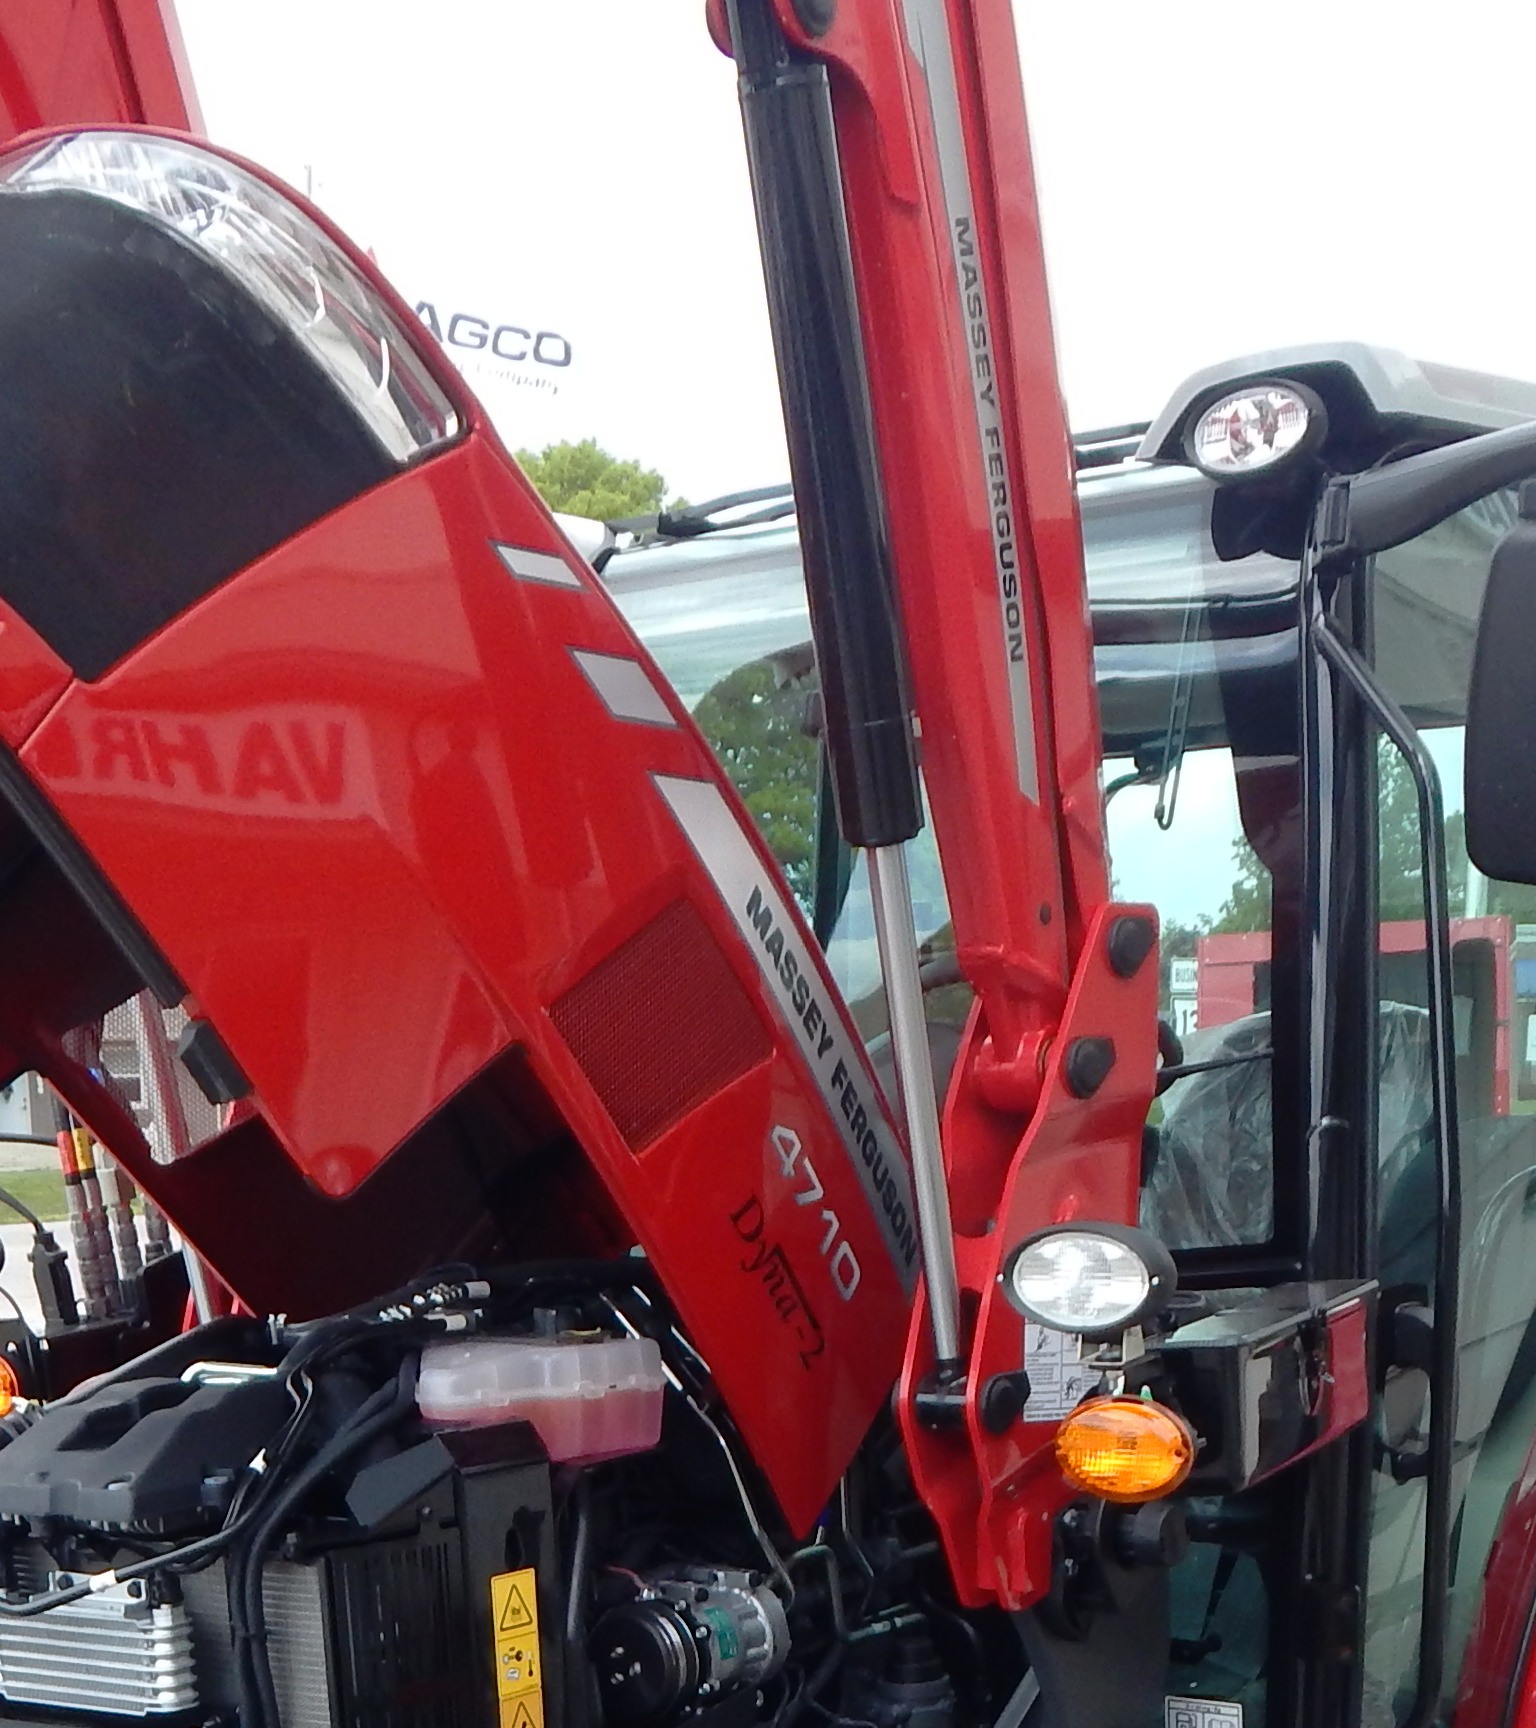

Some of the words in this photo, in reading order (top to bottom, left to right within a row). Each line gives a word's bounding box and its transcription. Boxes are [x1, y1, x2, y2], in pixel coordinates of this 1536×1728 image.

[415, 300, 572, 367] AGCO
[954, 216, 996, 409] MASSEY
[984, 427, 1027, 664] FERGUSON
[745, 884, 834, 1061] MASSEY
[830, 1056, 919, 1268] FERGUSON
[729, 1192, 826, 1372] Dyna-2
[770, 1123, 862, 1302] 4710
